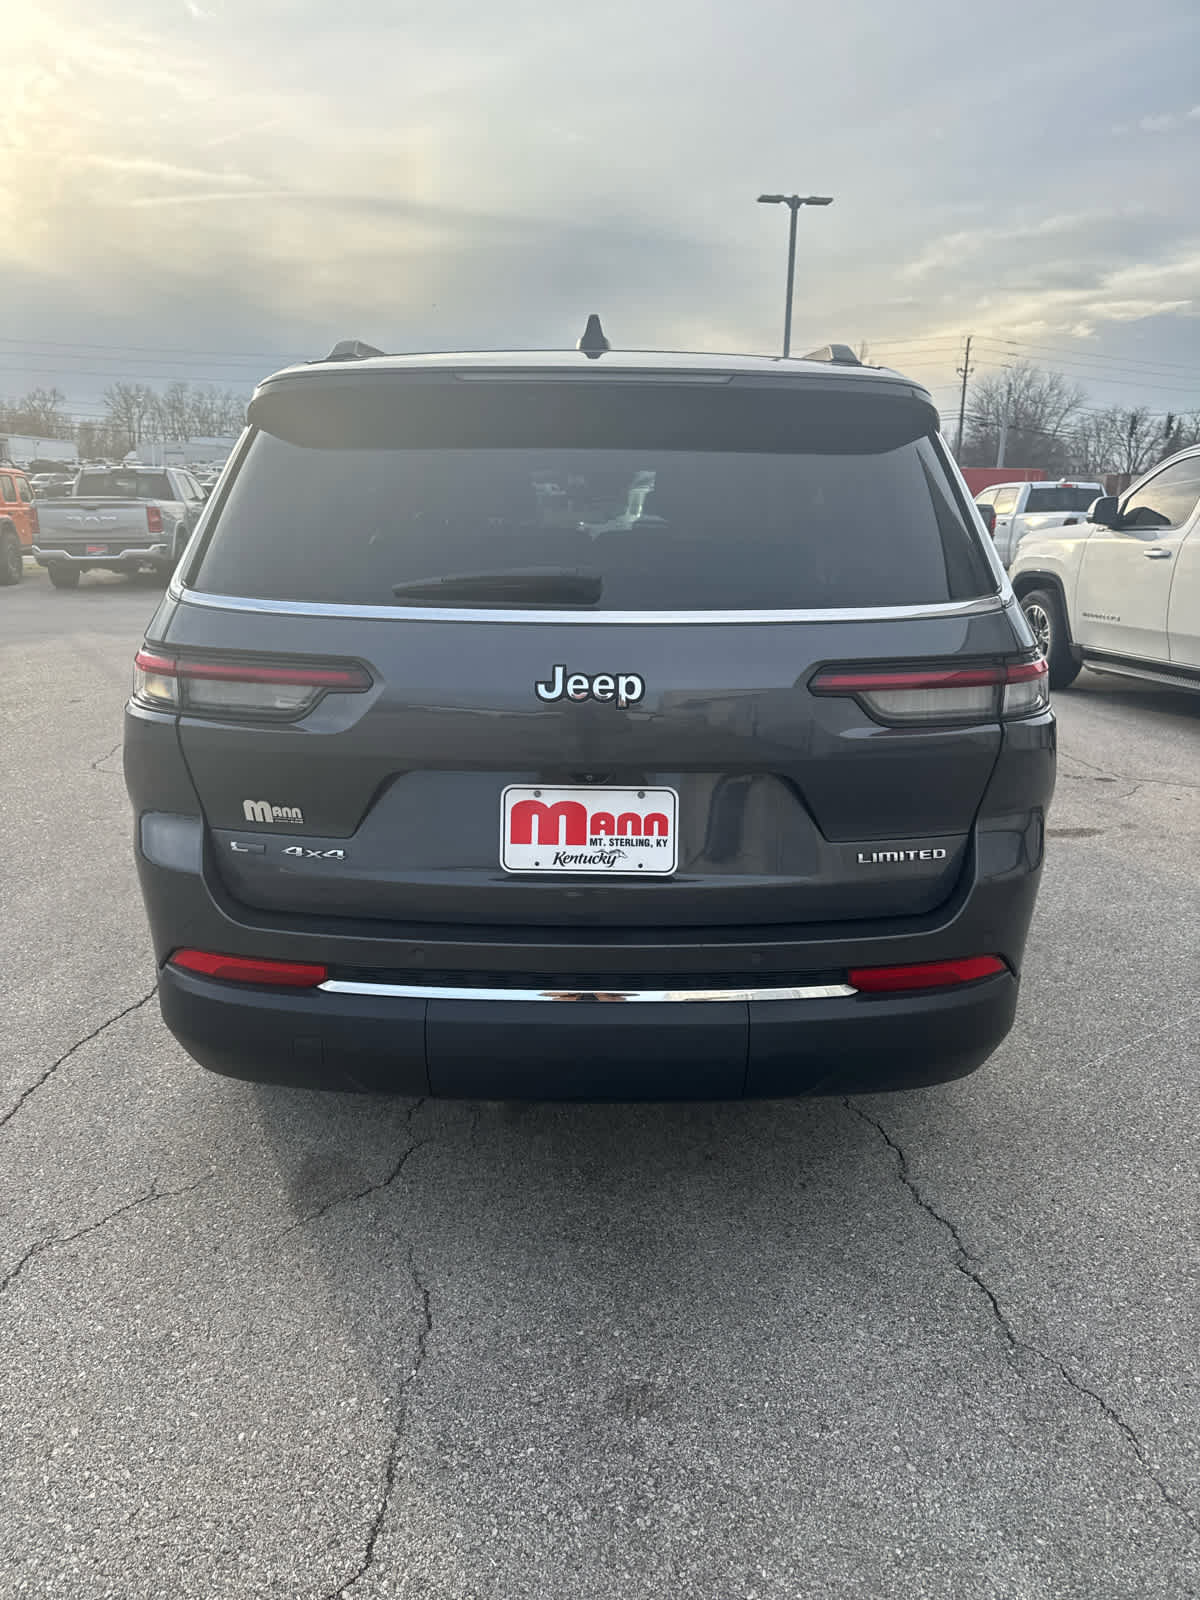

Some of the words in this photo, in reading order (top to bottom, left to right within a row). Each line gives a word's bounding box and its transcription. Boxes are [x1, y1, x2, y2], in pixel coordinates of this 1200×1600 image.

[536, 665, 643, 708] Jeep
[589, 838, 606, 847] MT.
[609, 838, 654, 848] STERLING,
[656, 839, 668, 848] KY
[280, 846, 346, 860] 4x4
[552, 850, 618, 868] Kentucky
[857, 848, 947, 863] LIMITED
